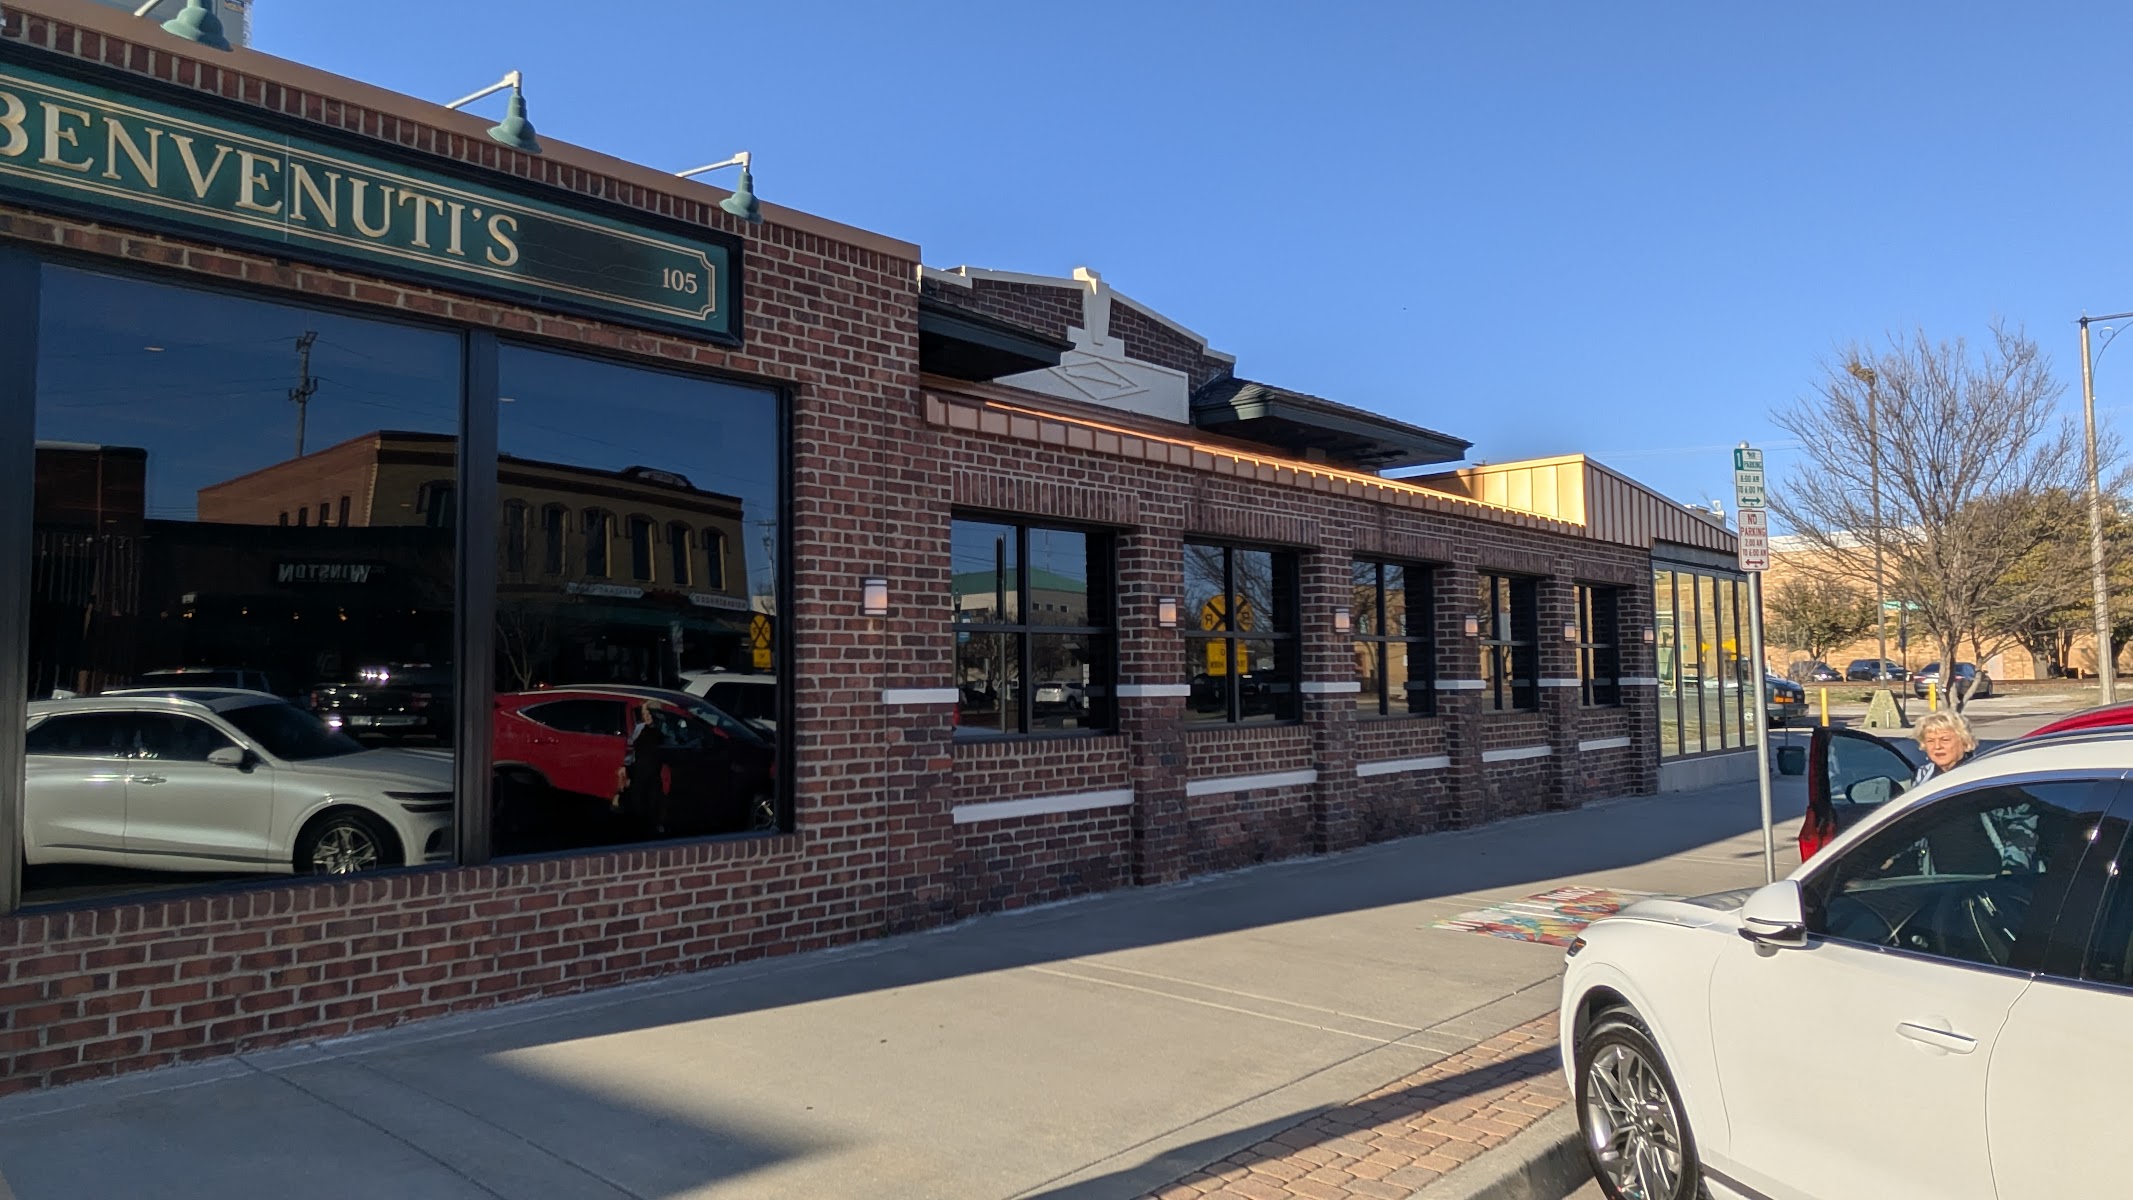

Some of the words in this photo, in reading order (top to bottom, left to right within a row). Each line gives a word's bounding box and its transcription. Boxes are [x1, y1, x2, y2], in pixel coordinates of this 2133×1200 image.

[662, 267, 698, 294] 105
[1736, 452, 1741, 468] 1
[1757, 486, 1764, 494] PM
[1747, 514, 1758, 525] NO
[1740, 527, 1766, 537] PARKING
